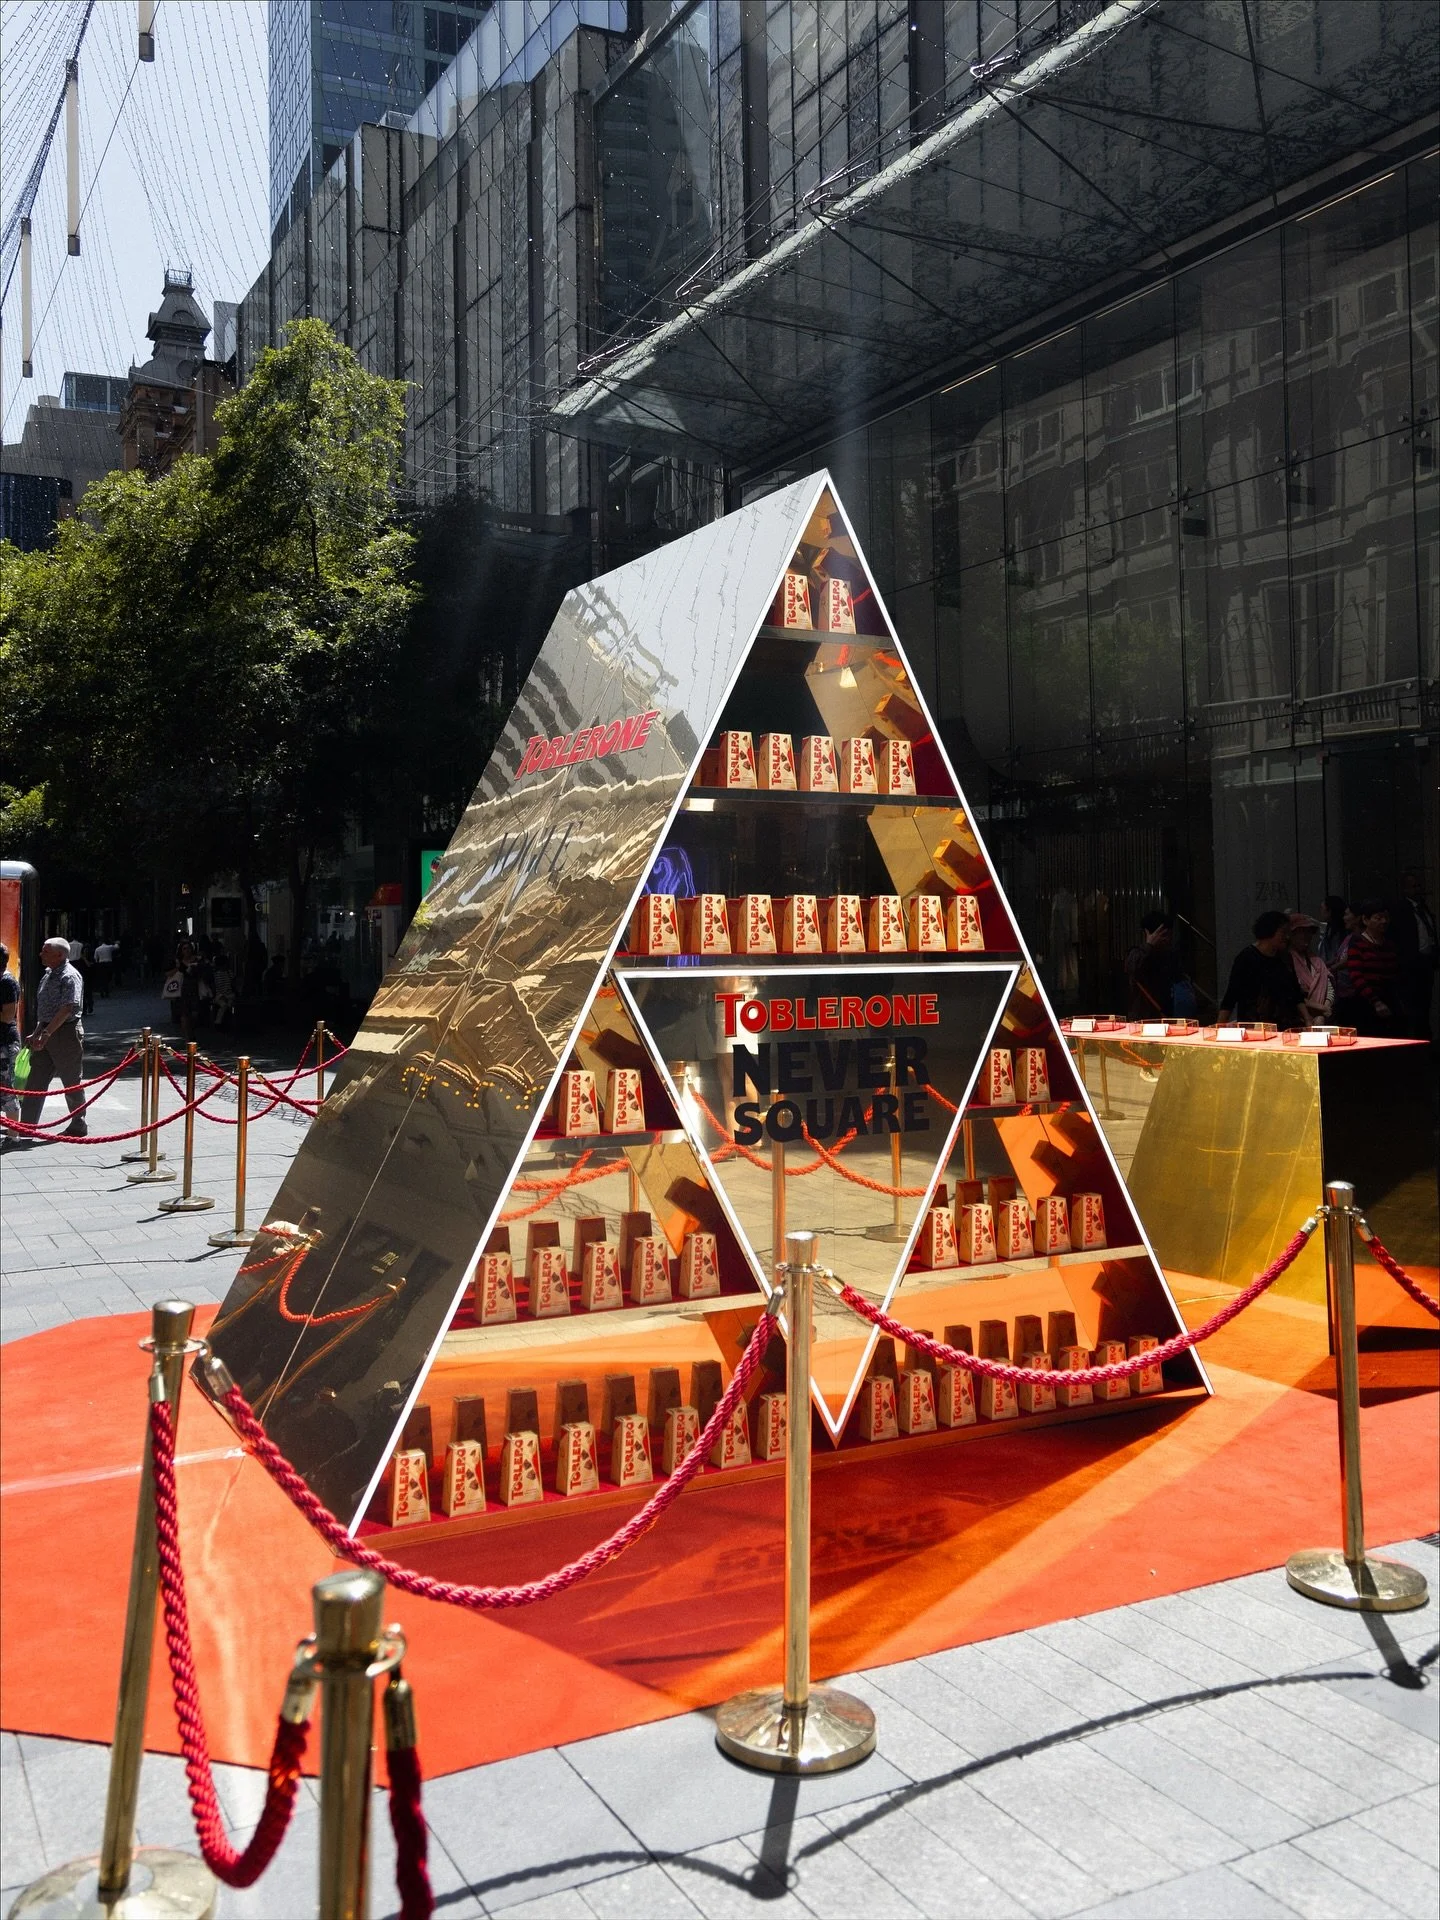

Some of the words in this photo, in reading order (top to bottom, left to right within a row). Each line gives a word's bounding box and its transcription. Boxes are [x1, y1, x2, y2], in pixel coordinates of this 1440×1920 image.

[514, 710, 661, 781] TOBLERONE
[715, 992, 939, 1037] TOBLERONE
[733, 1036, 931, 1097] NEVER
[734, 1091, 930, 1146] SQUARE
